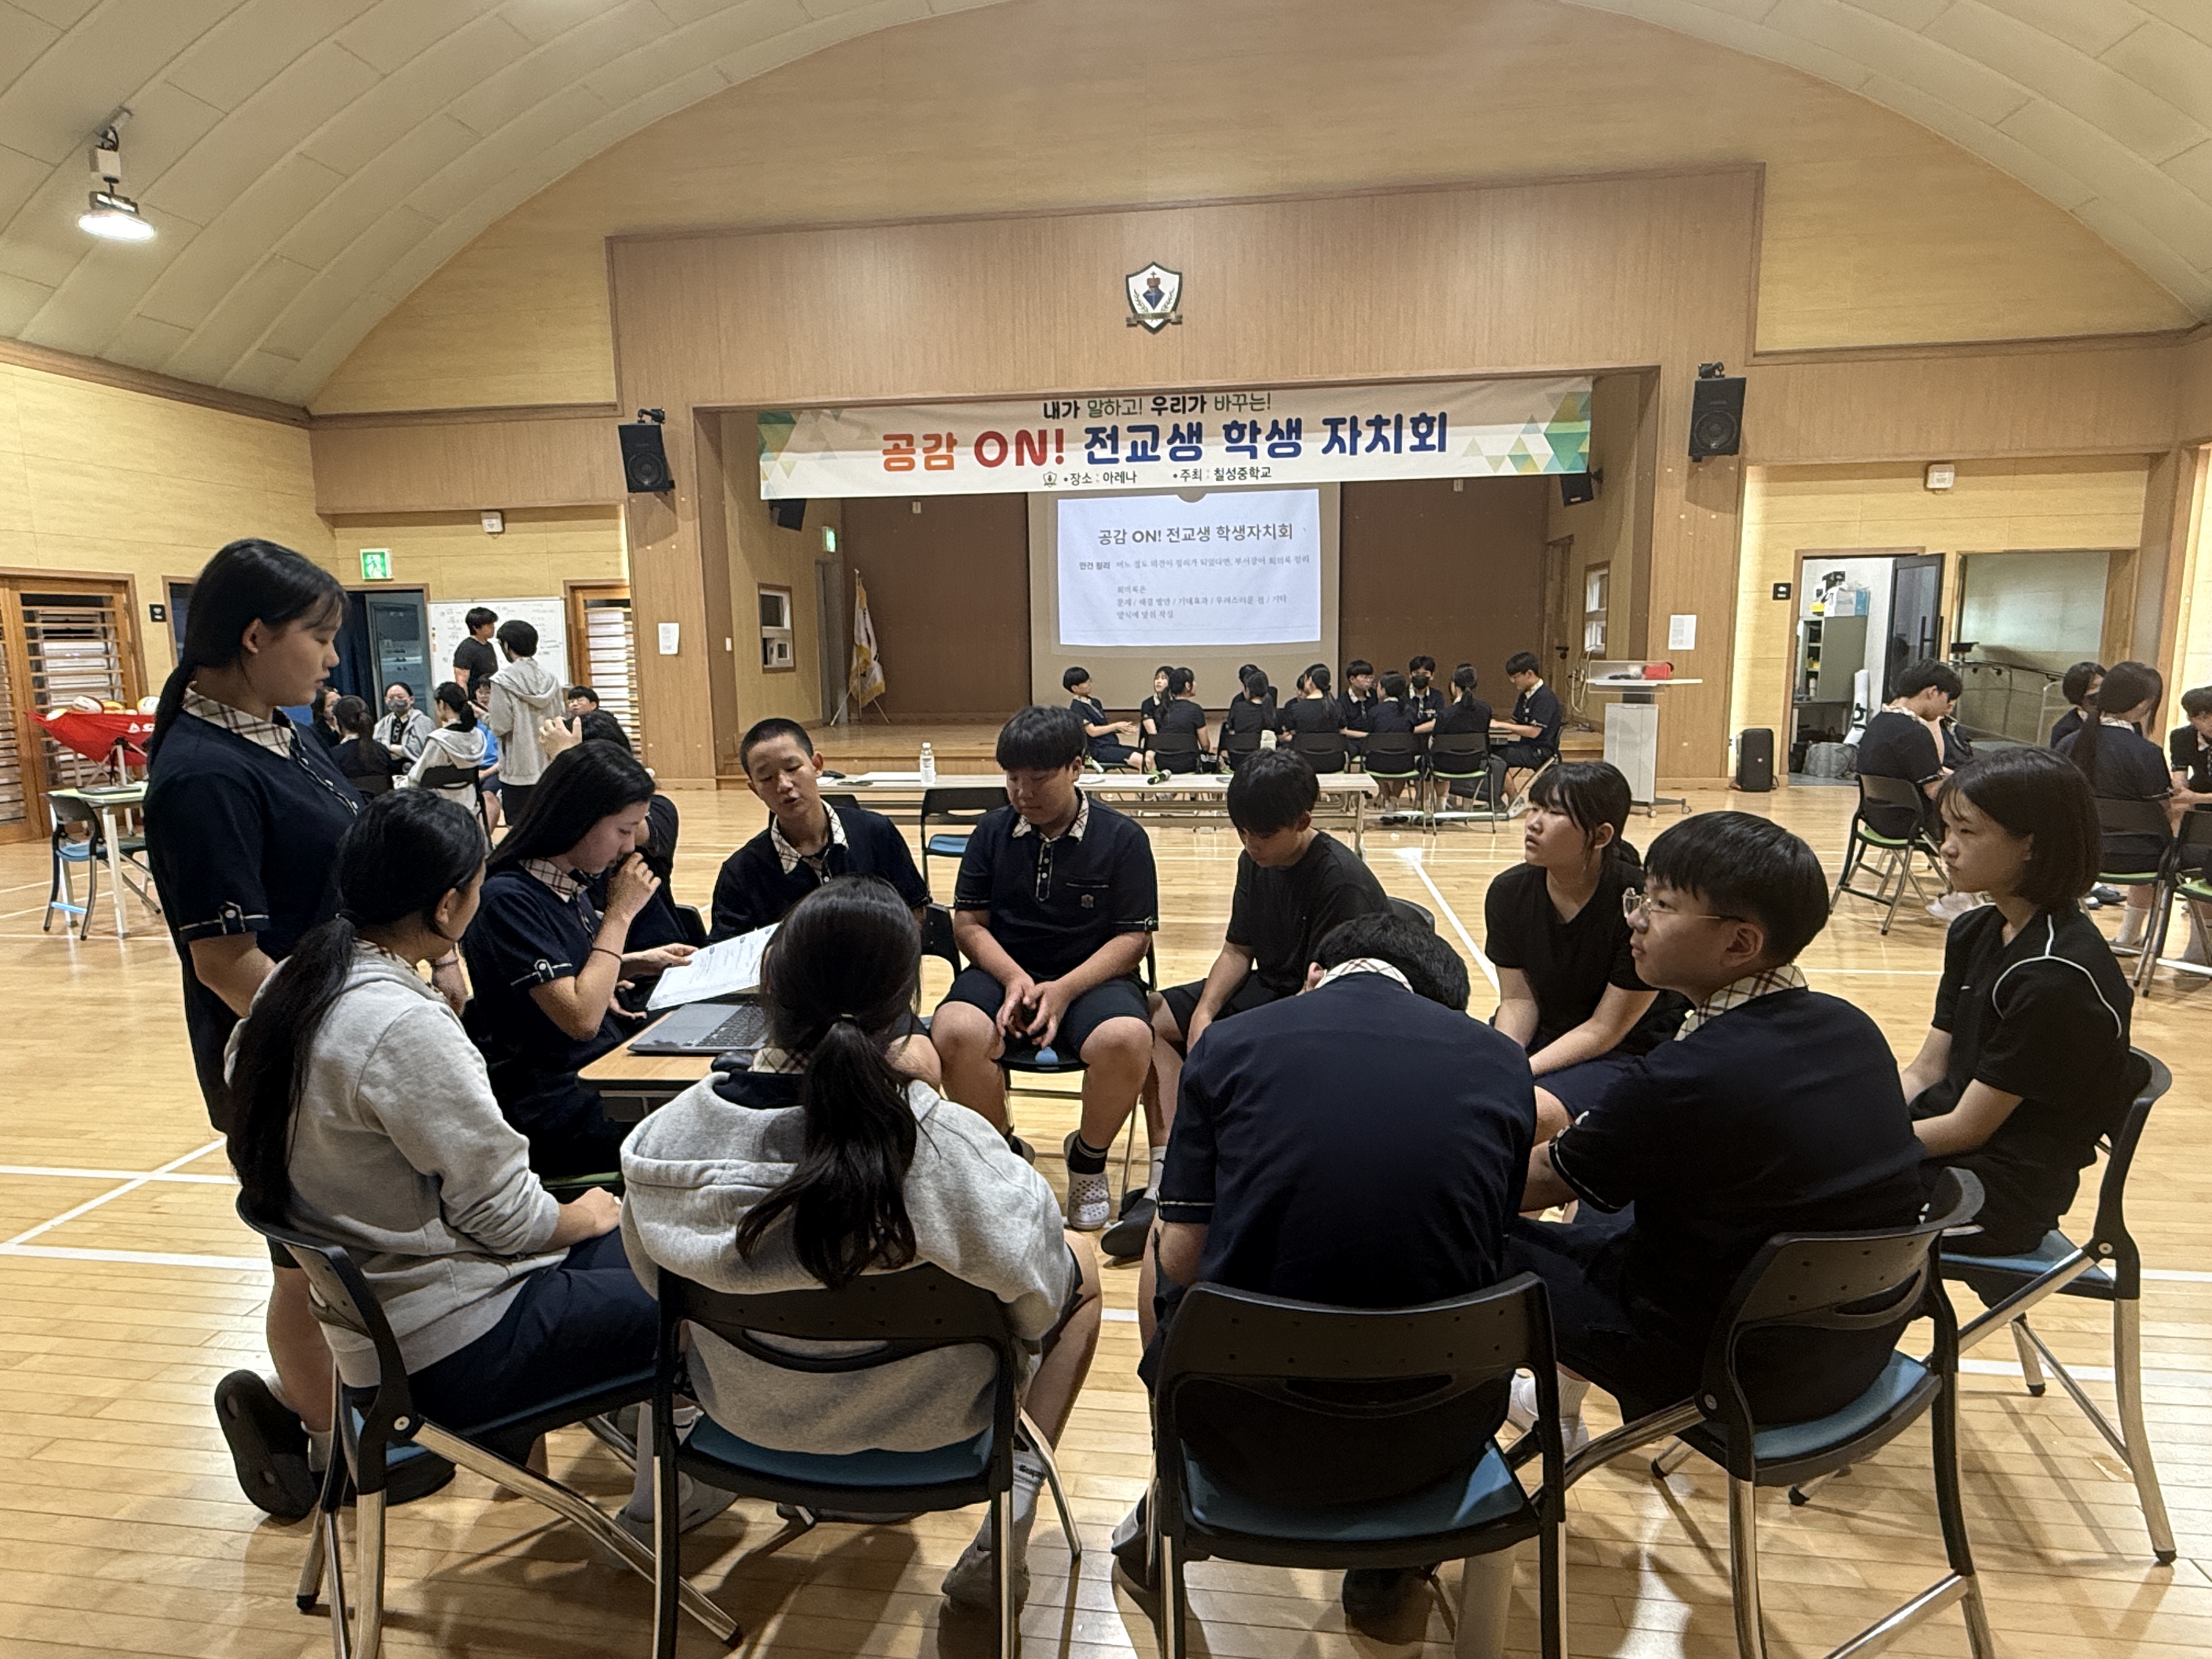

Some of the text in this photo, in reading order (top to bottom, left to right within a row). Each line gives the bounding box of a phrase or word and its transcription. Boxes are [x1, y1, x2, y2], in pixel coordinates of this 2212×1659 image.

[1043, 393, 1271, 419] 내가 말하고! 우리가 바꾸는!
[882, 411, 1447, 472] 공감 ON! 전교생 학생 자치회
[1103, 471, 1137, 484] 아레나
[1214, 466, 1272, 481] 칠성중학교
[1098, 523, 1293, 545] 공감 ON! 전교생 학생자치회
